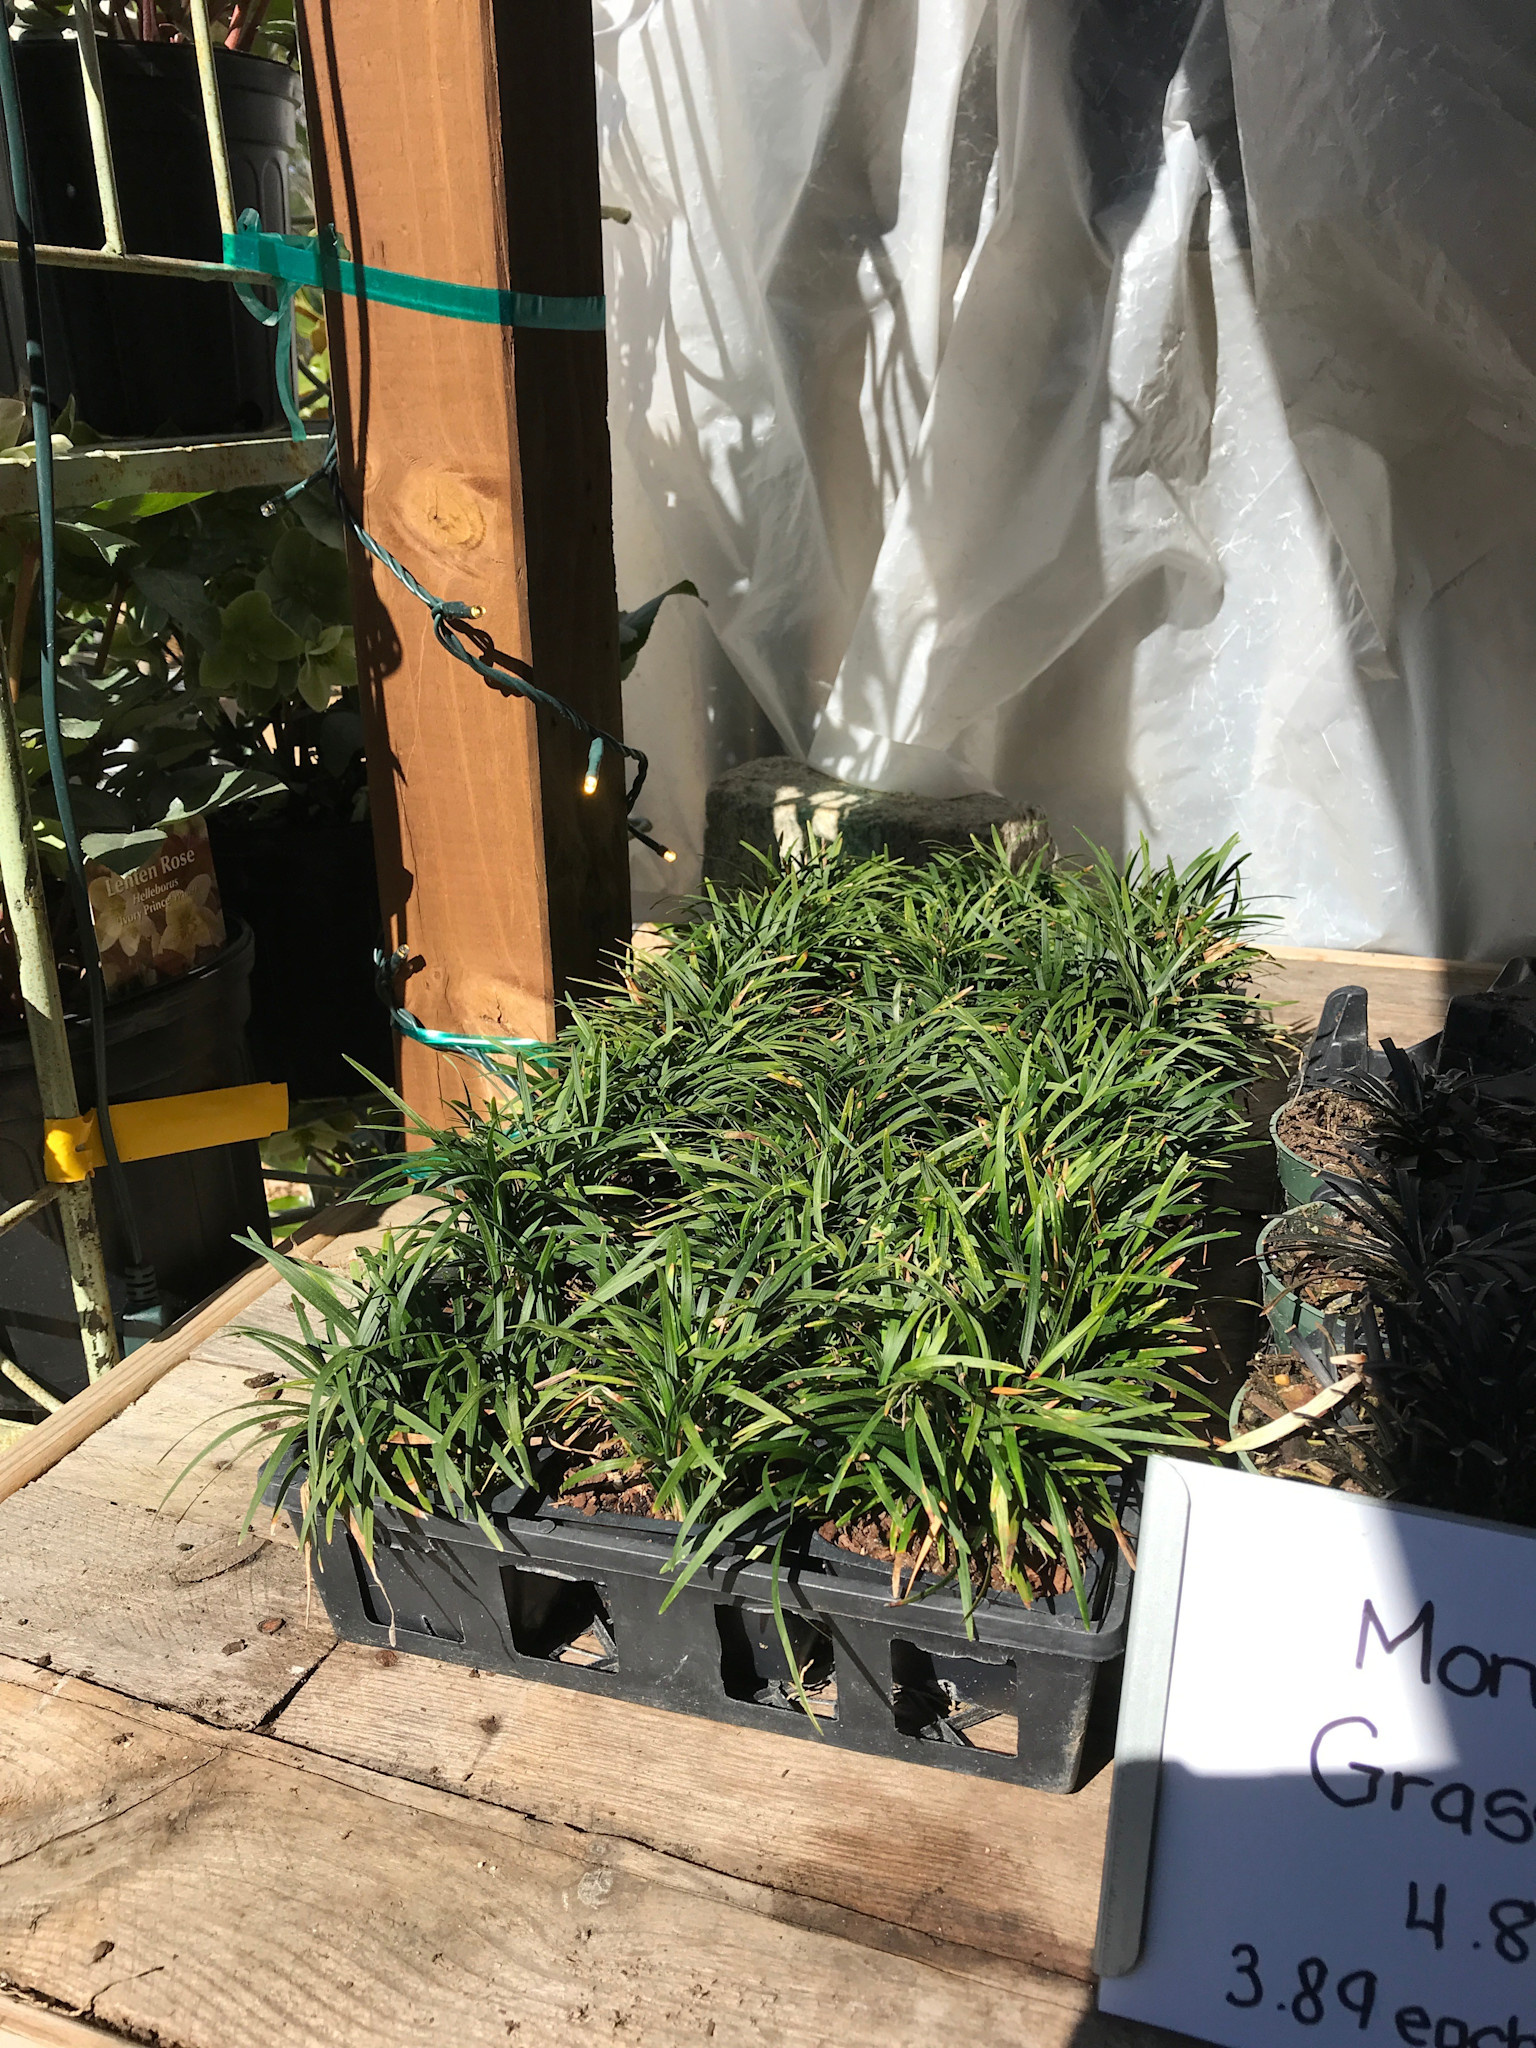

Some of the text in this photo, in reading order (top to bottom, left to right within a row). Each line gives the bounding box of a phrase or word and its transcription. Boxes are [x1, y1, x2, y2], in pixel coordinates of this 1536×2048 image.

[104, 865, 158, 897] Lenten
[160, 849, 196, 874] Rose
[133, 878, 179, 905] Helleborus
[1310, 1715, 1536, 1844] Gras
[1226, 1944, 1378, 2031] 3.89
